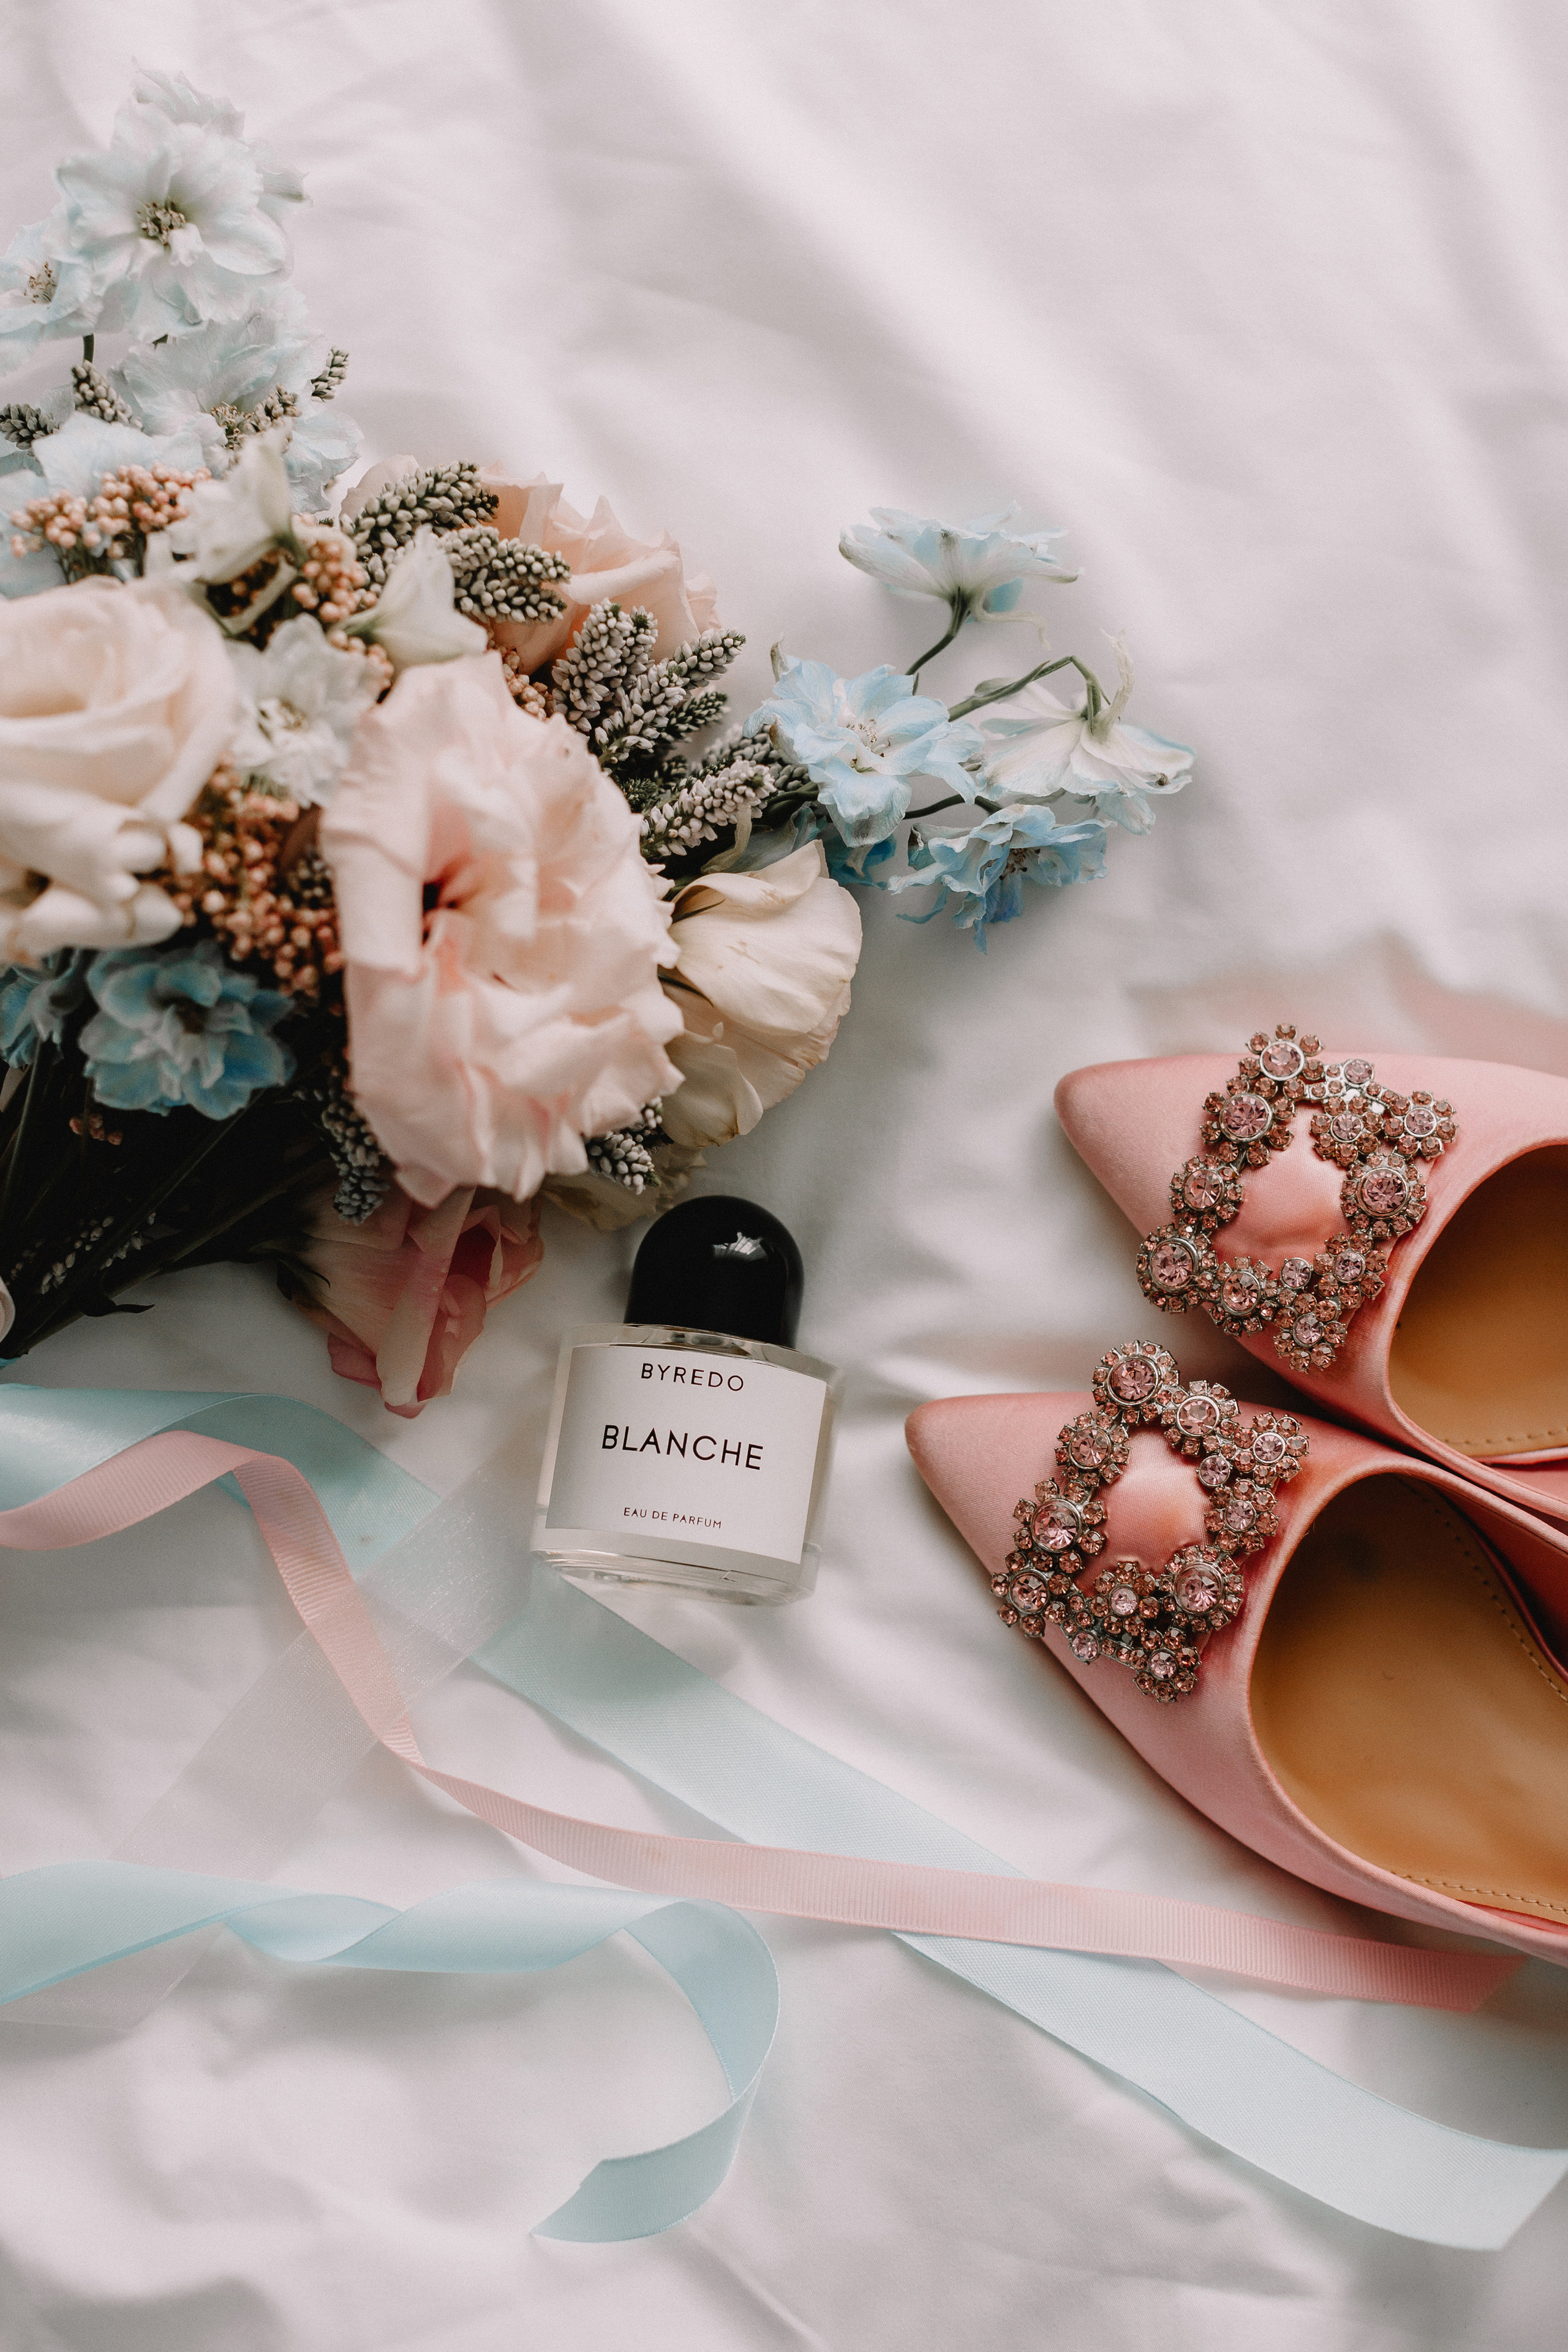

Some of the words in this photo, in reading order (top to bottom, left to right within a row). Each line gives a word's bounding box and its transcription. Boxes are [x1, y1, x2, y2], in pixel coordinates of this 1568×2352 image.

[641, 1363, 744, 1392] BYREDO
[601, 1425, 764, 1471] BLANCHE
[624, 1507, 647, 1518] EAU
[652, 1510, 668, 1521] DE
[673, 1513, 722, 1529] PARFUM
